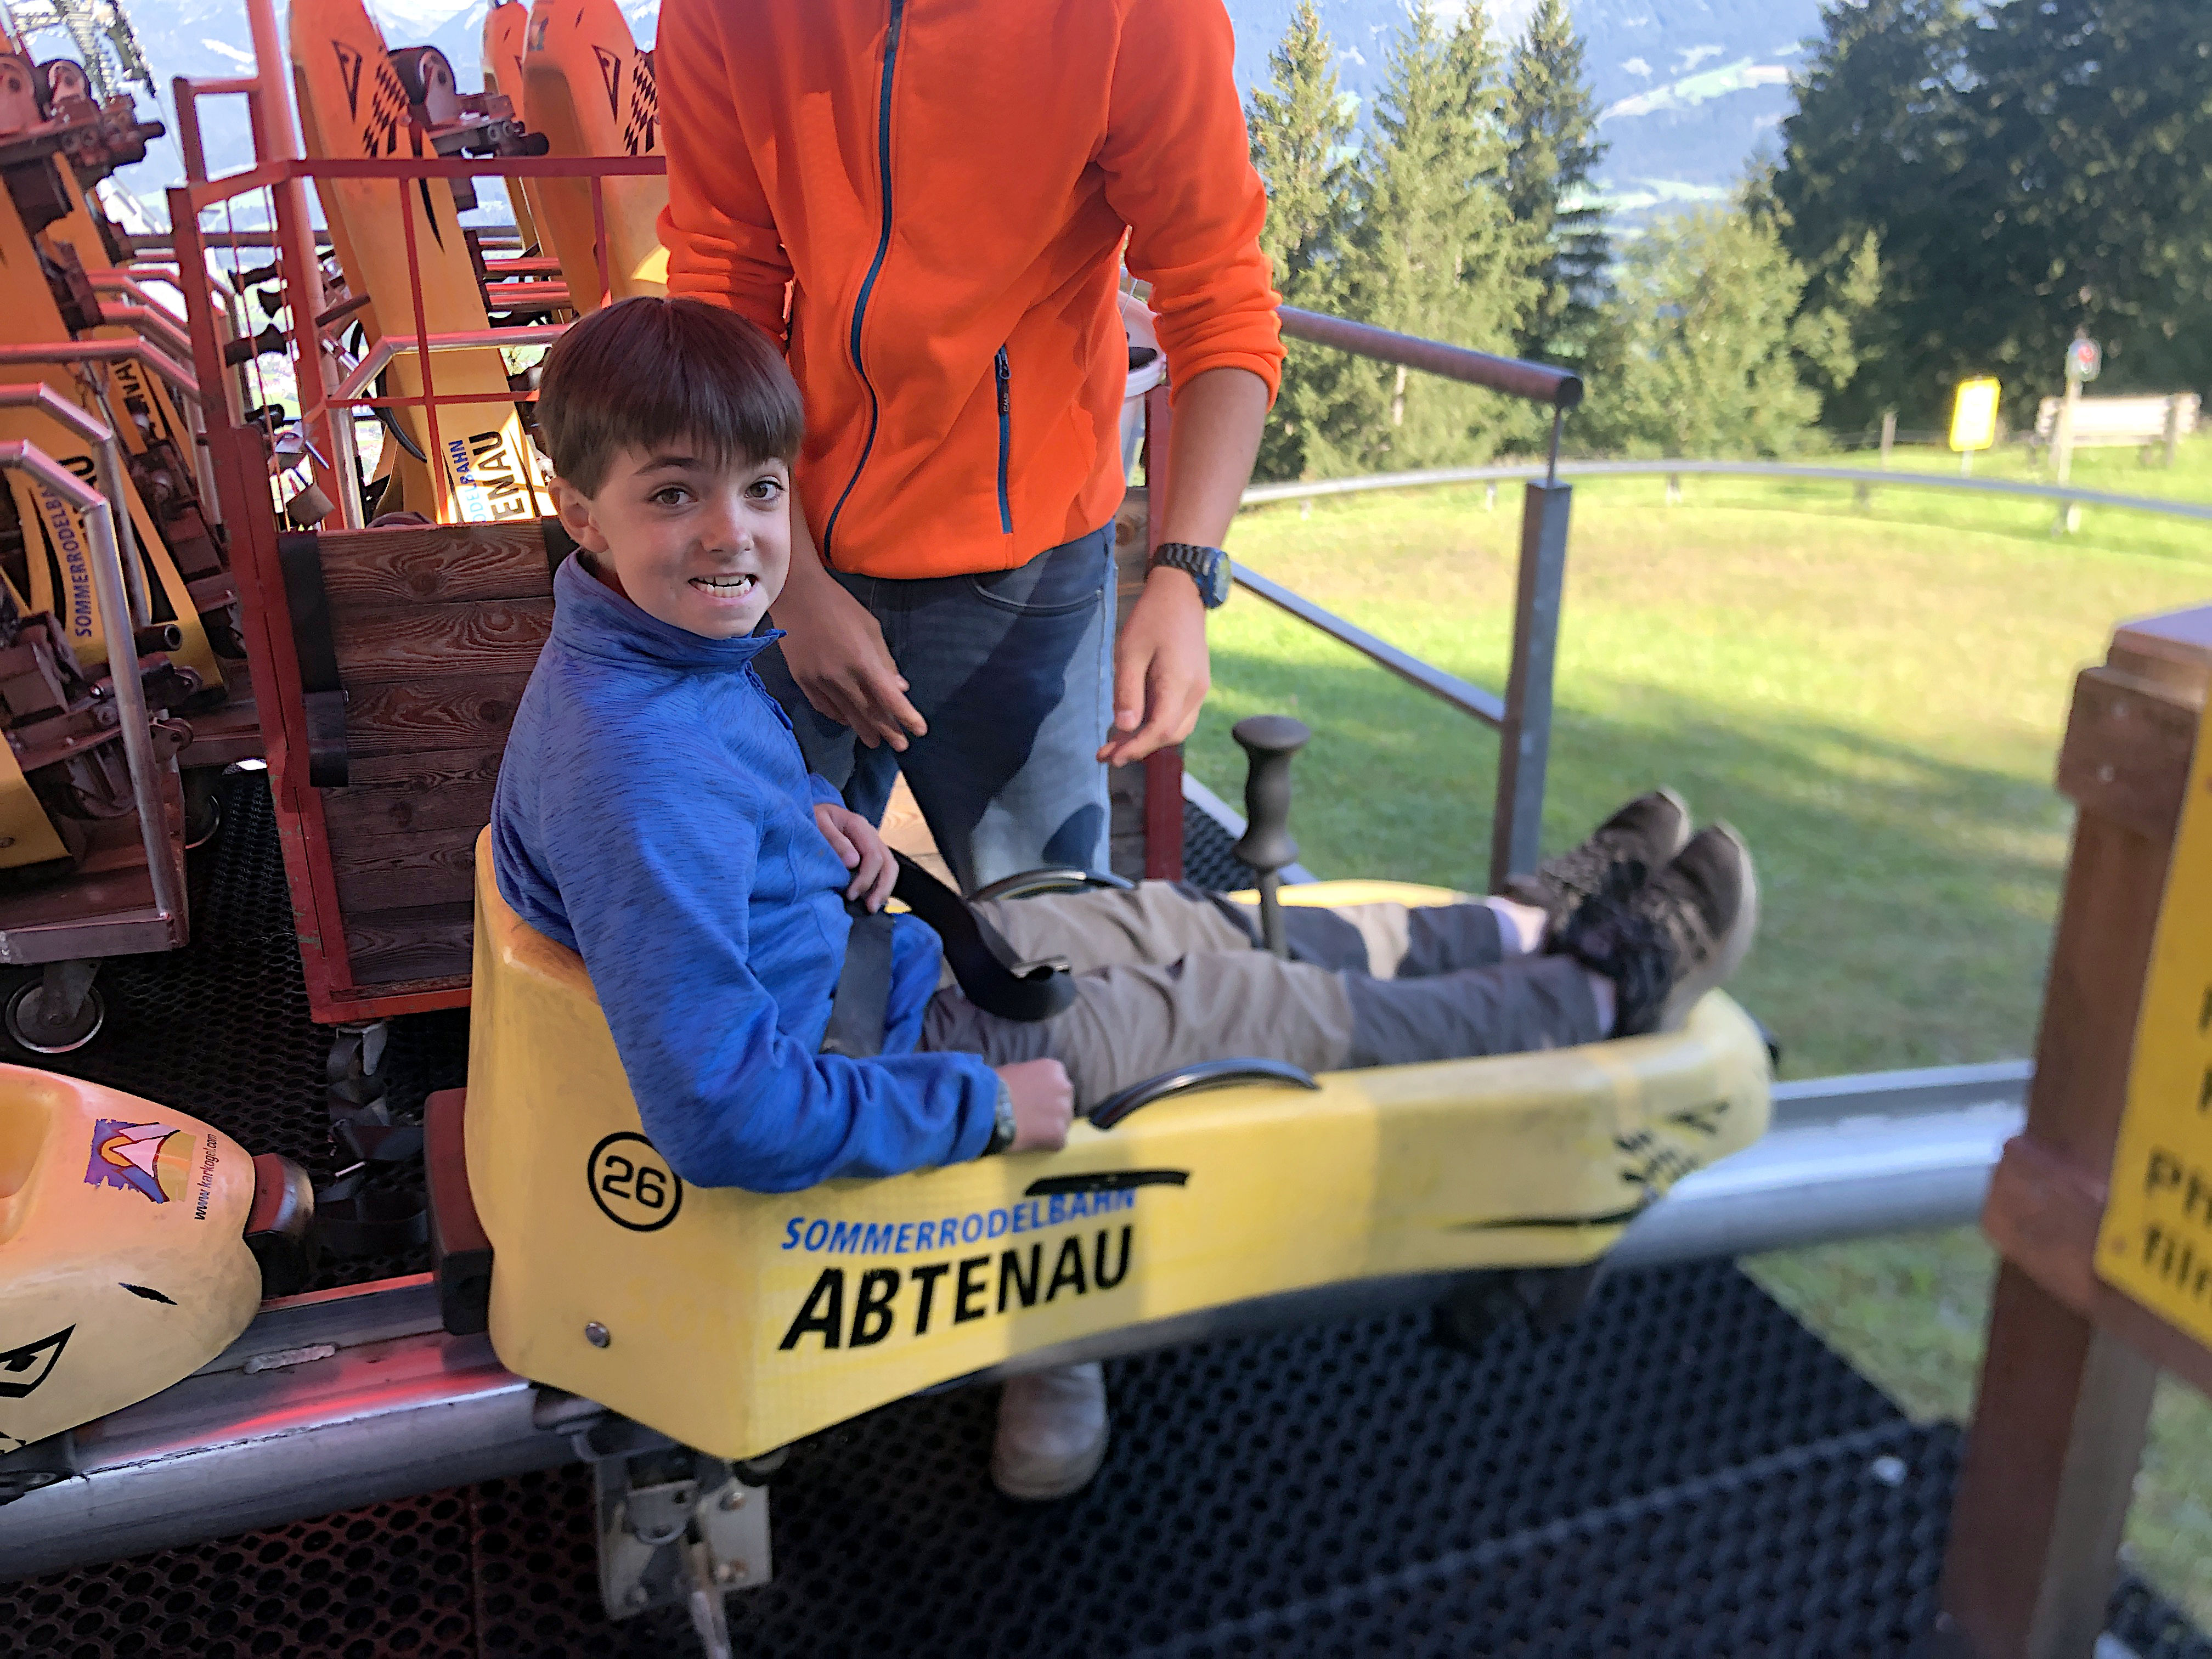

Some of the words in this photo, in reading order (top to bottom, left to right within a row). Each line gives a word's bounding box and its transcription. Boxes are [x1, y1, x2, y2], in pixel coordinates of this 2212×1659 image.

[448, 439, 487, 522] ODELBAHN
[468, 431, 525, 520] ENAU
[38, 483, 92, 637] SOMMERRODELBA
[194, 1133, 219, 1220] wwwkarkogel.com
[602, 1155, 666, 1209] 26
[781, 1187, 1136, 1255] SOMMERRODELBAHN
[777, 1223, 1132, 1351] ABTENAU
